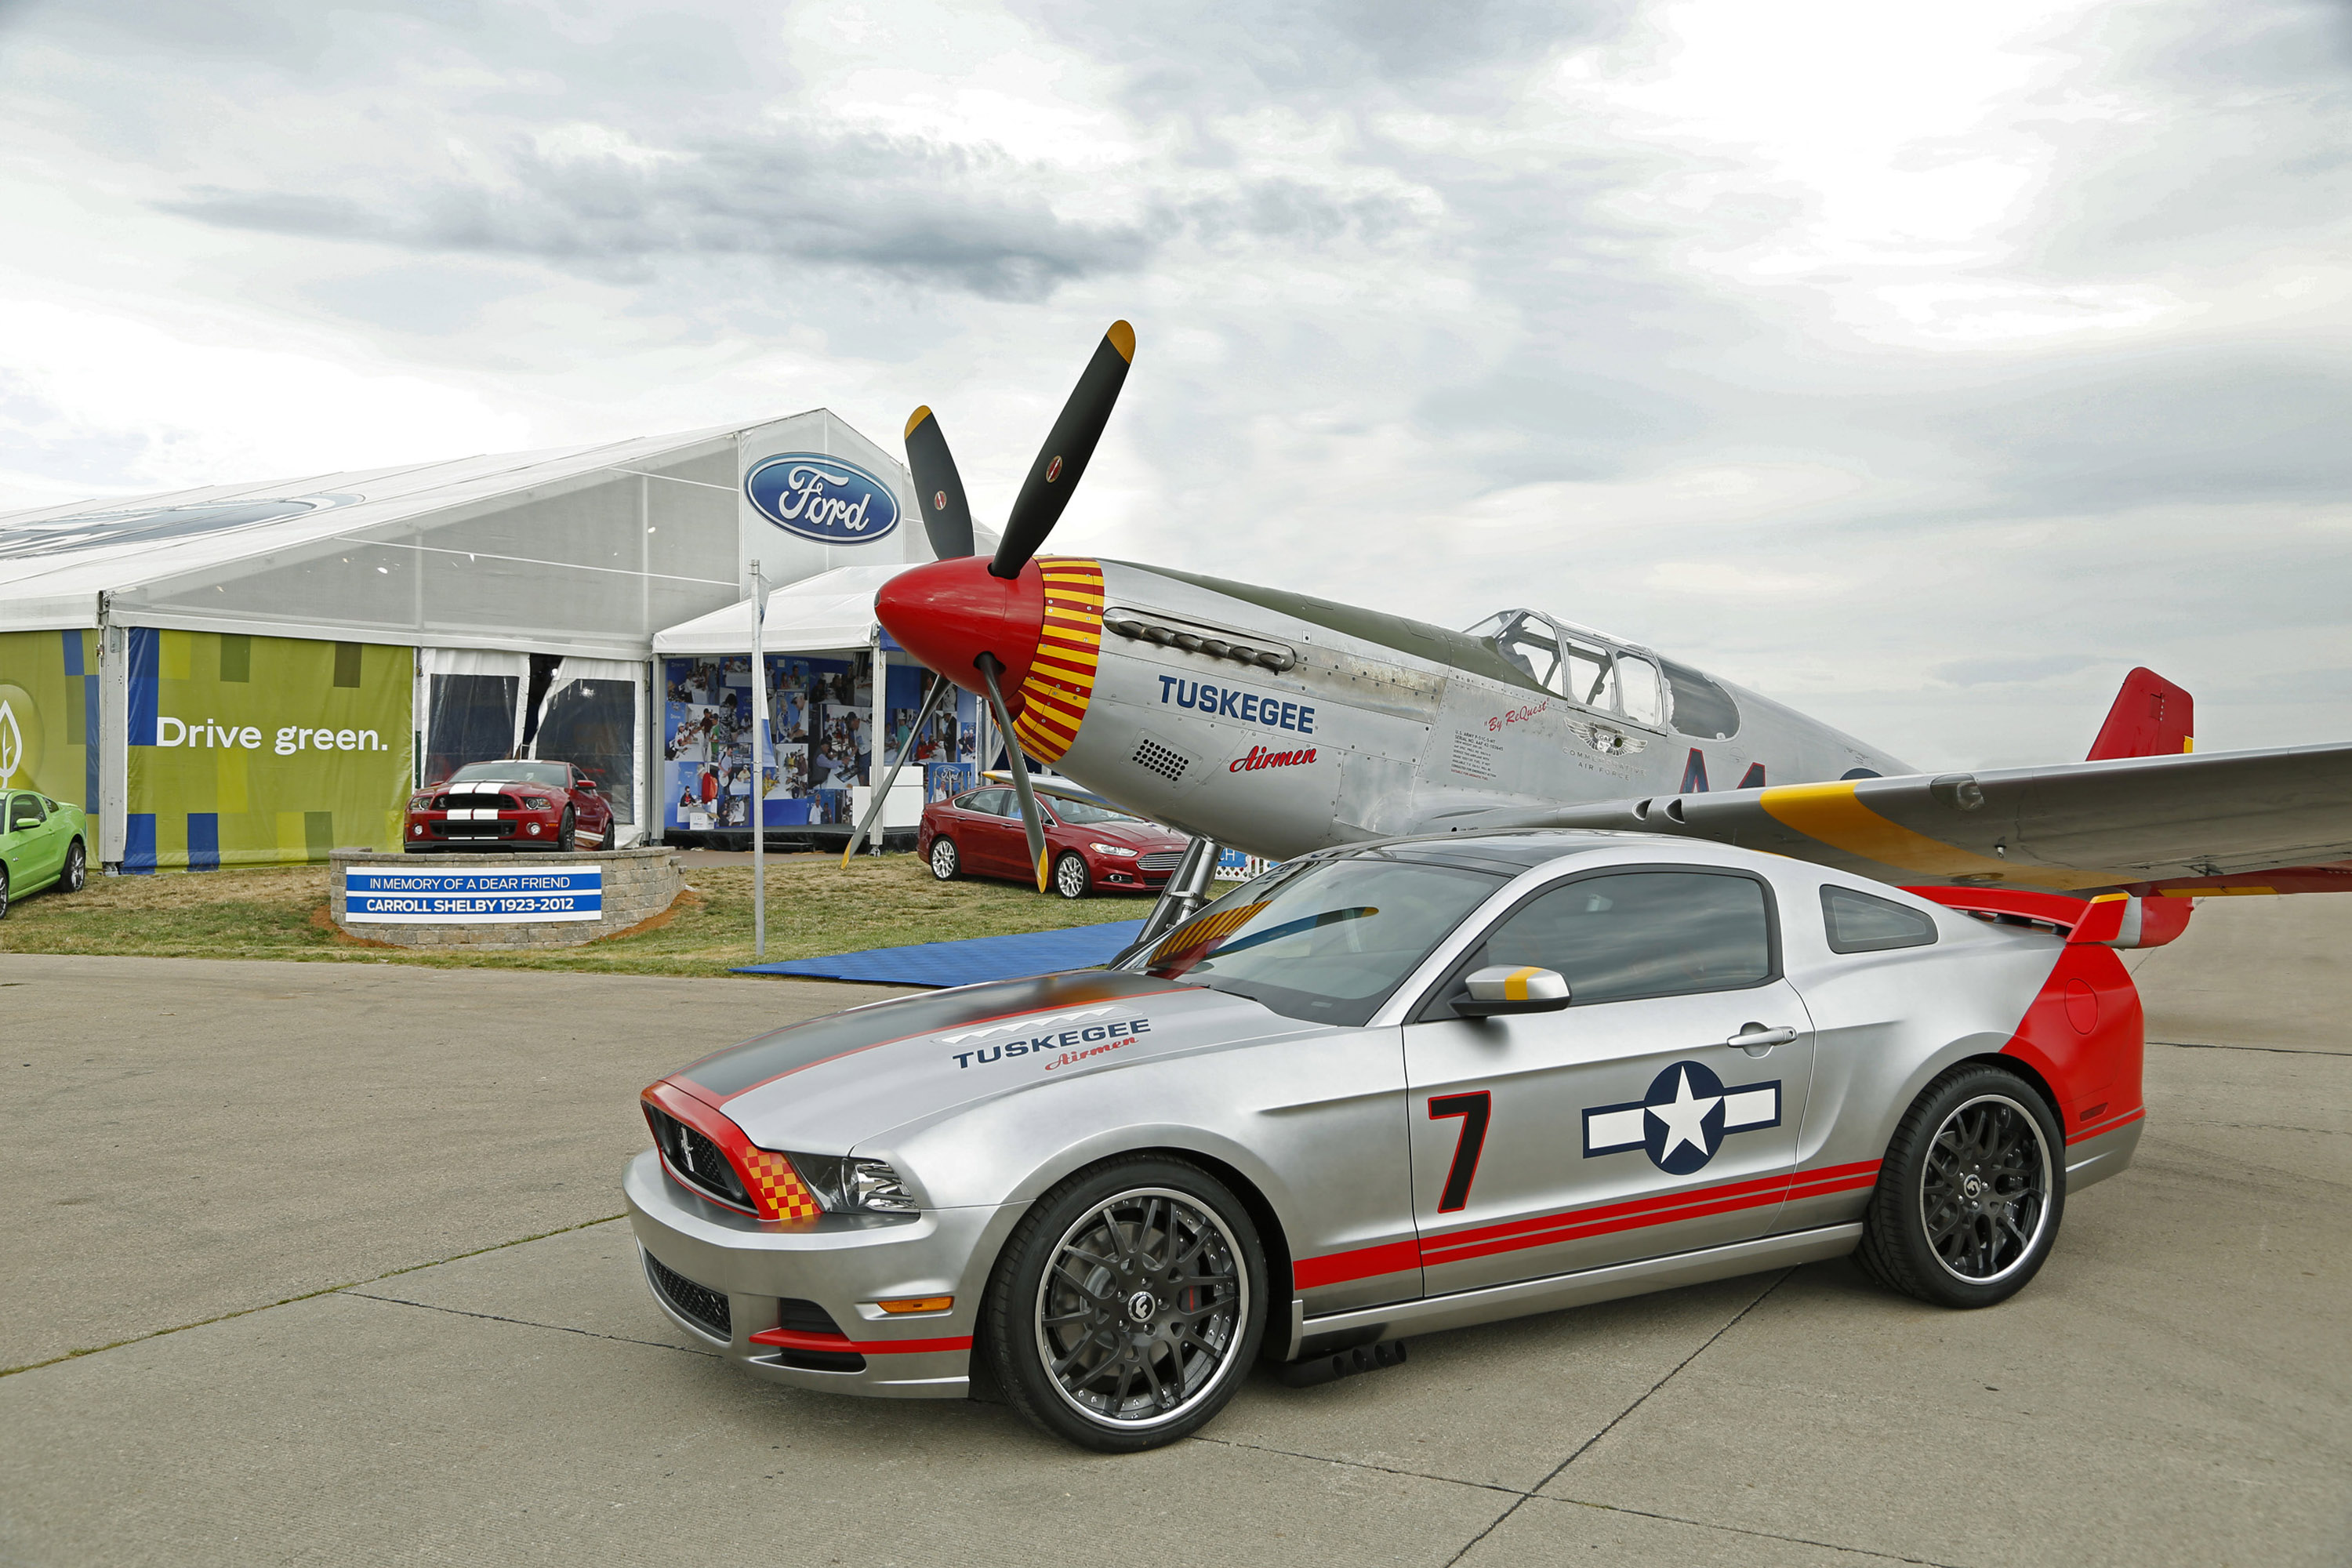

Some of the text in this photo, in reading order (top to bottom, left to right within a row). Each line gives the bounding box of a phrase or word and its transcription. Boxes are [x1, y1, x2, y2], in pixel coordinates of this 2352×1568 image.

[779, 466, 872, 532] Ford
[1159, 675, 1316, 734] TUSKEGEE
[157, 717, 388, 756] Drive green.
[1229, 746, 1317, 772] Airmen
[1578, 762, 1630, 781] AIR FORCE
[370, 877, 570, 890] IN MEMORY OF A DEAR FRIEND
[367, 898, 574, 912] CARROLL SHELBY 1923-2012
[953, 1018, 1152, 1069] TUSKEGEE
[1045, 1036, 1140, 1071] Airmen
[1428, 1090, 1491, 1214] 7
